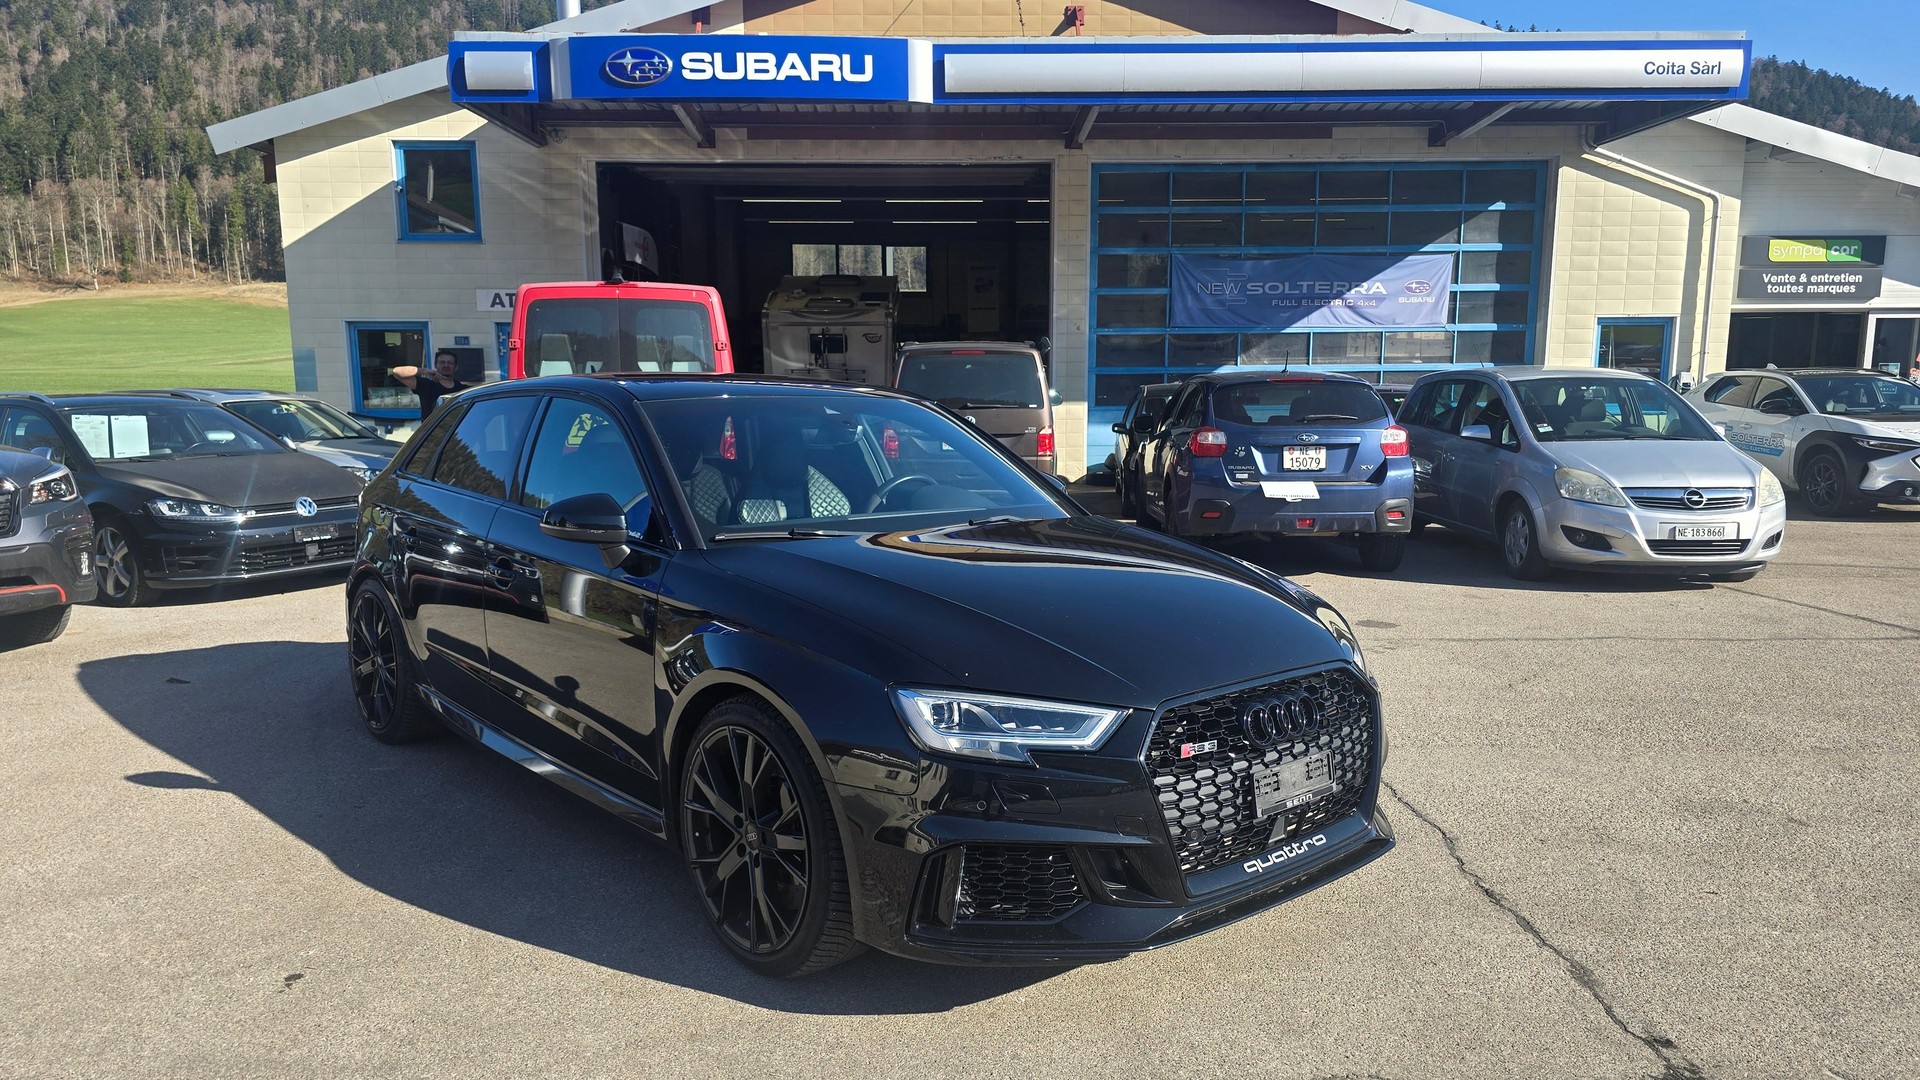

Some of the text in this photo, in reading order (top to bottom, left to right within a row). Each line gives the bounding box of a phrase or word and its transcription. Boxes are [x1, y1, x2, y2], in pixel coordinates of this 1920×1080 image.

[681, 52, 873, 82] SUBARU
[1644, 61, 1721, 75] Coita Sàrl
[1772, 244, 1858, 258] sympa car
[1762, 273, 1863, 283] Vente & entretien
[1197, 281, 1388, 295] NEW SOLTERRA
[1767, 284, 1856, 294] toutes marques
[1357, 299, 1376, 307] 4x4
[1730, 432, 1785, 448] SOLTERRA
[1300, 447, 1310, 455] NE
[1290, 457, 1321, 468] 15079
[1243, 834, 1327, 873] quattro
